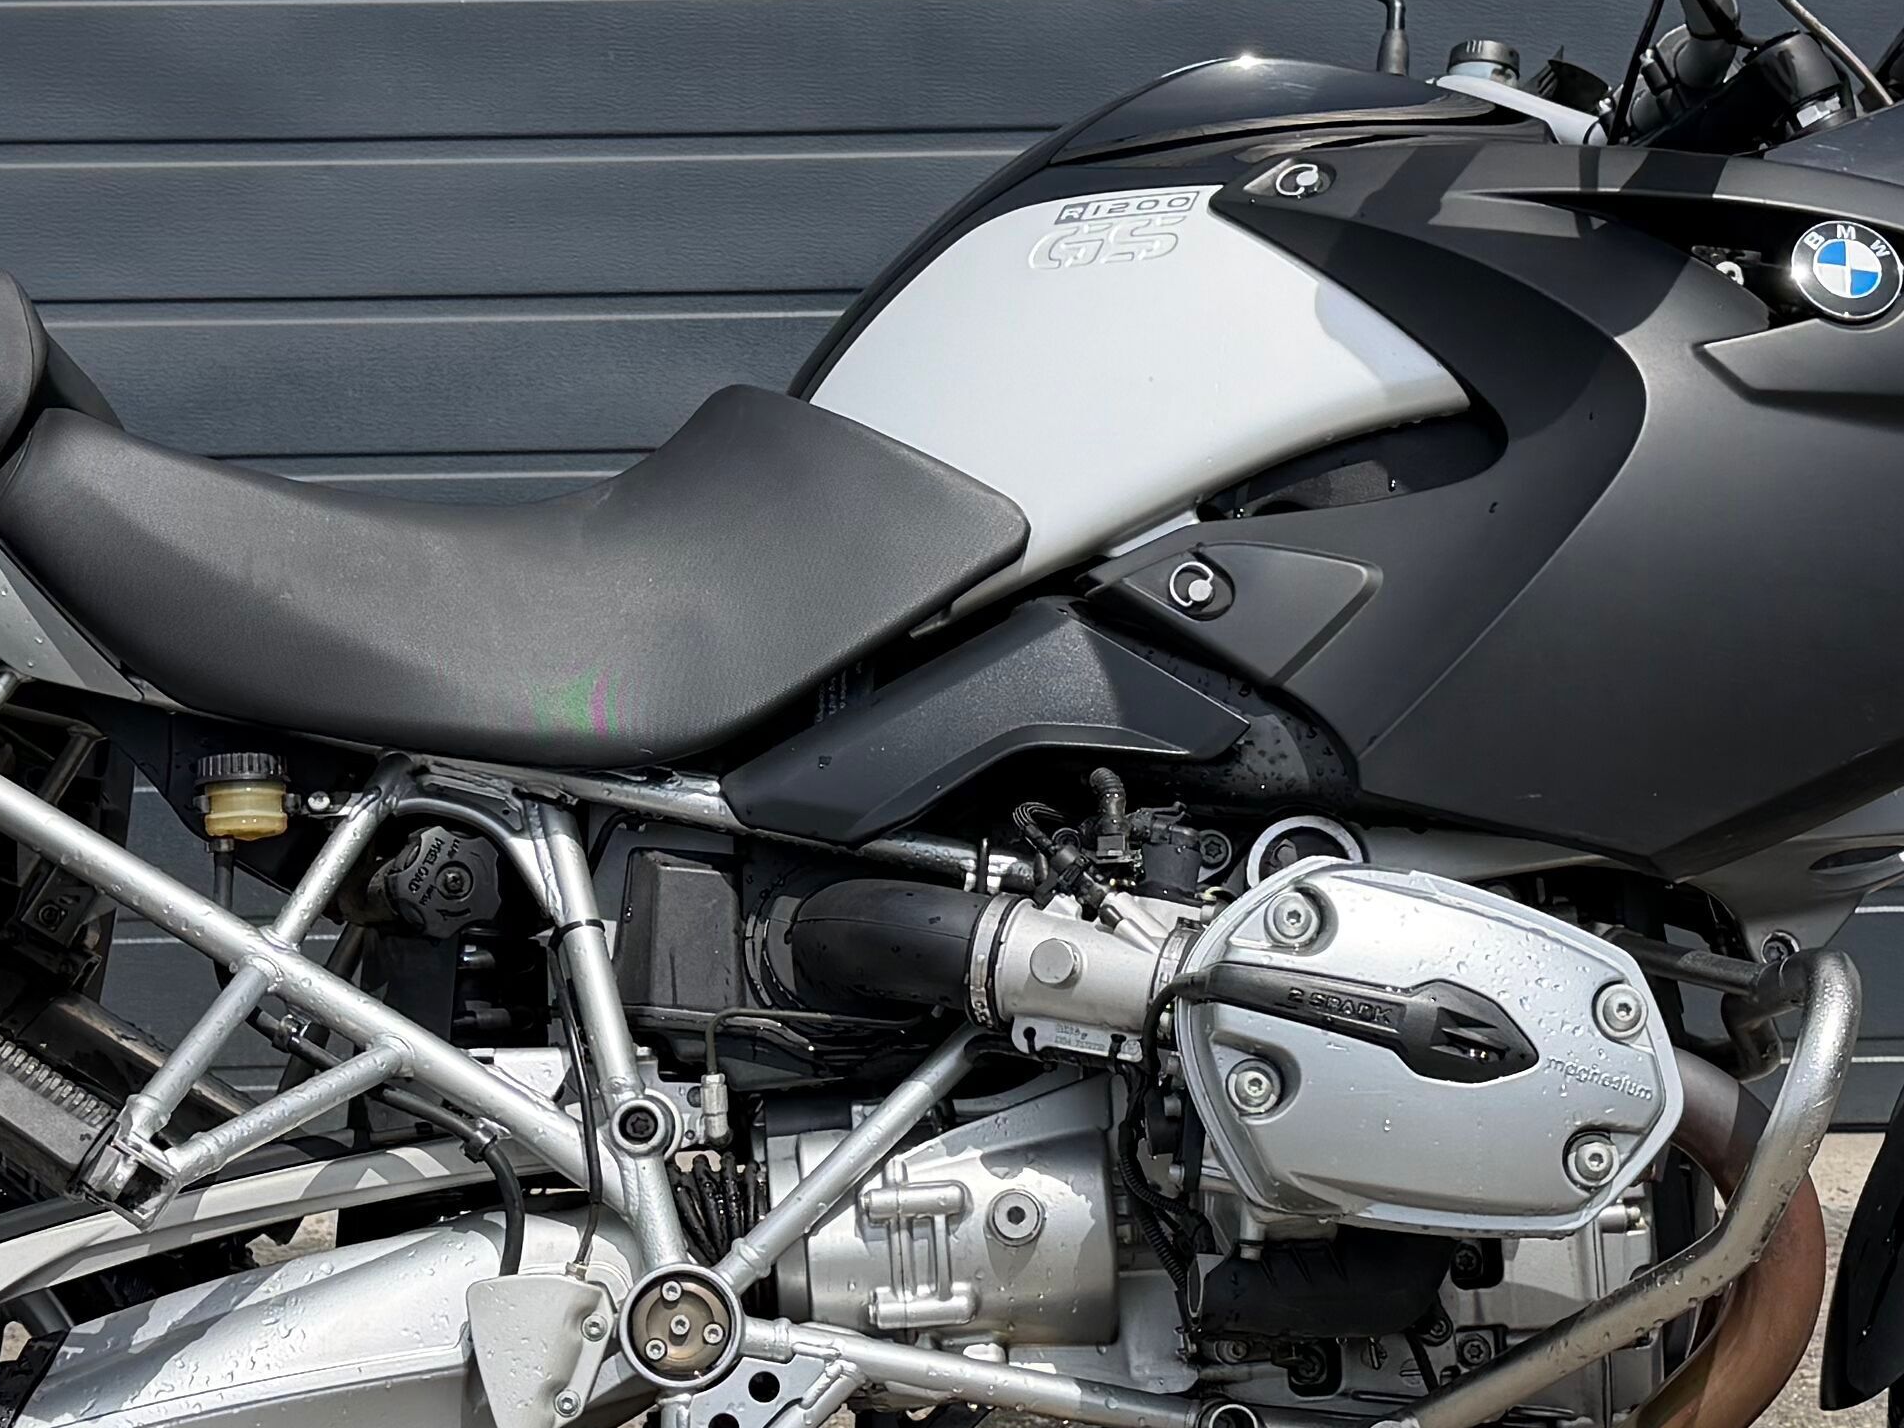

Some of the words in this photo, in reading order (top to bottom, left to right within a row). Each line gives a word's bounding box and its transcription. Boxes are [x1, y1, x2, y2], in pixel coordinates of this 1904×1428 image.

[1803, 223, 1893, 258] BMW
[1287, 986, 1305, 1003] 2
[1308, 991, 1394, 1024] SPARK
[1545, 1055, 1654, 1101] magnesium
